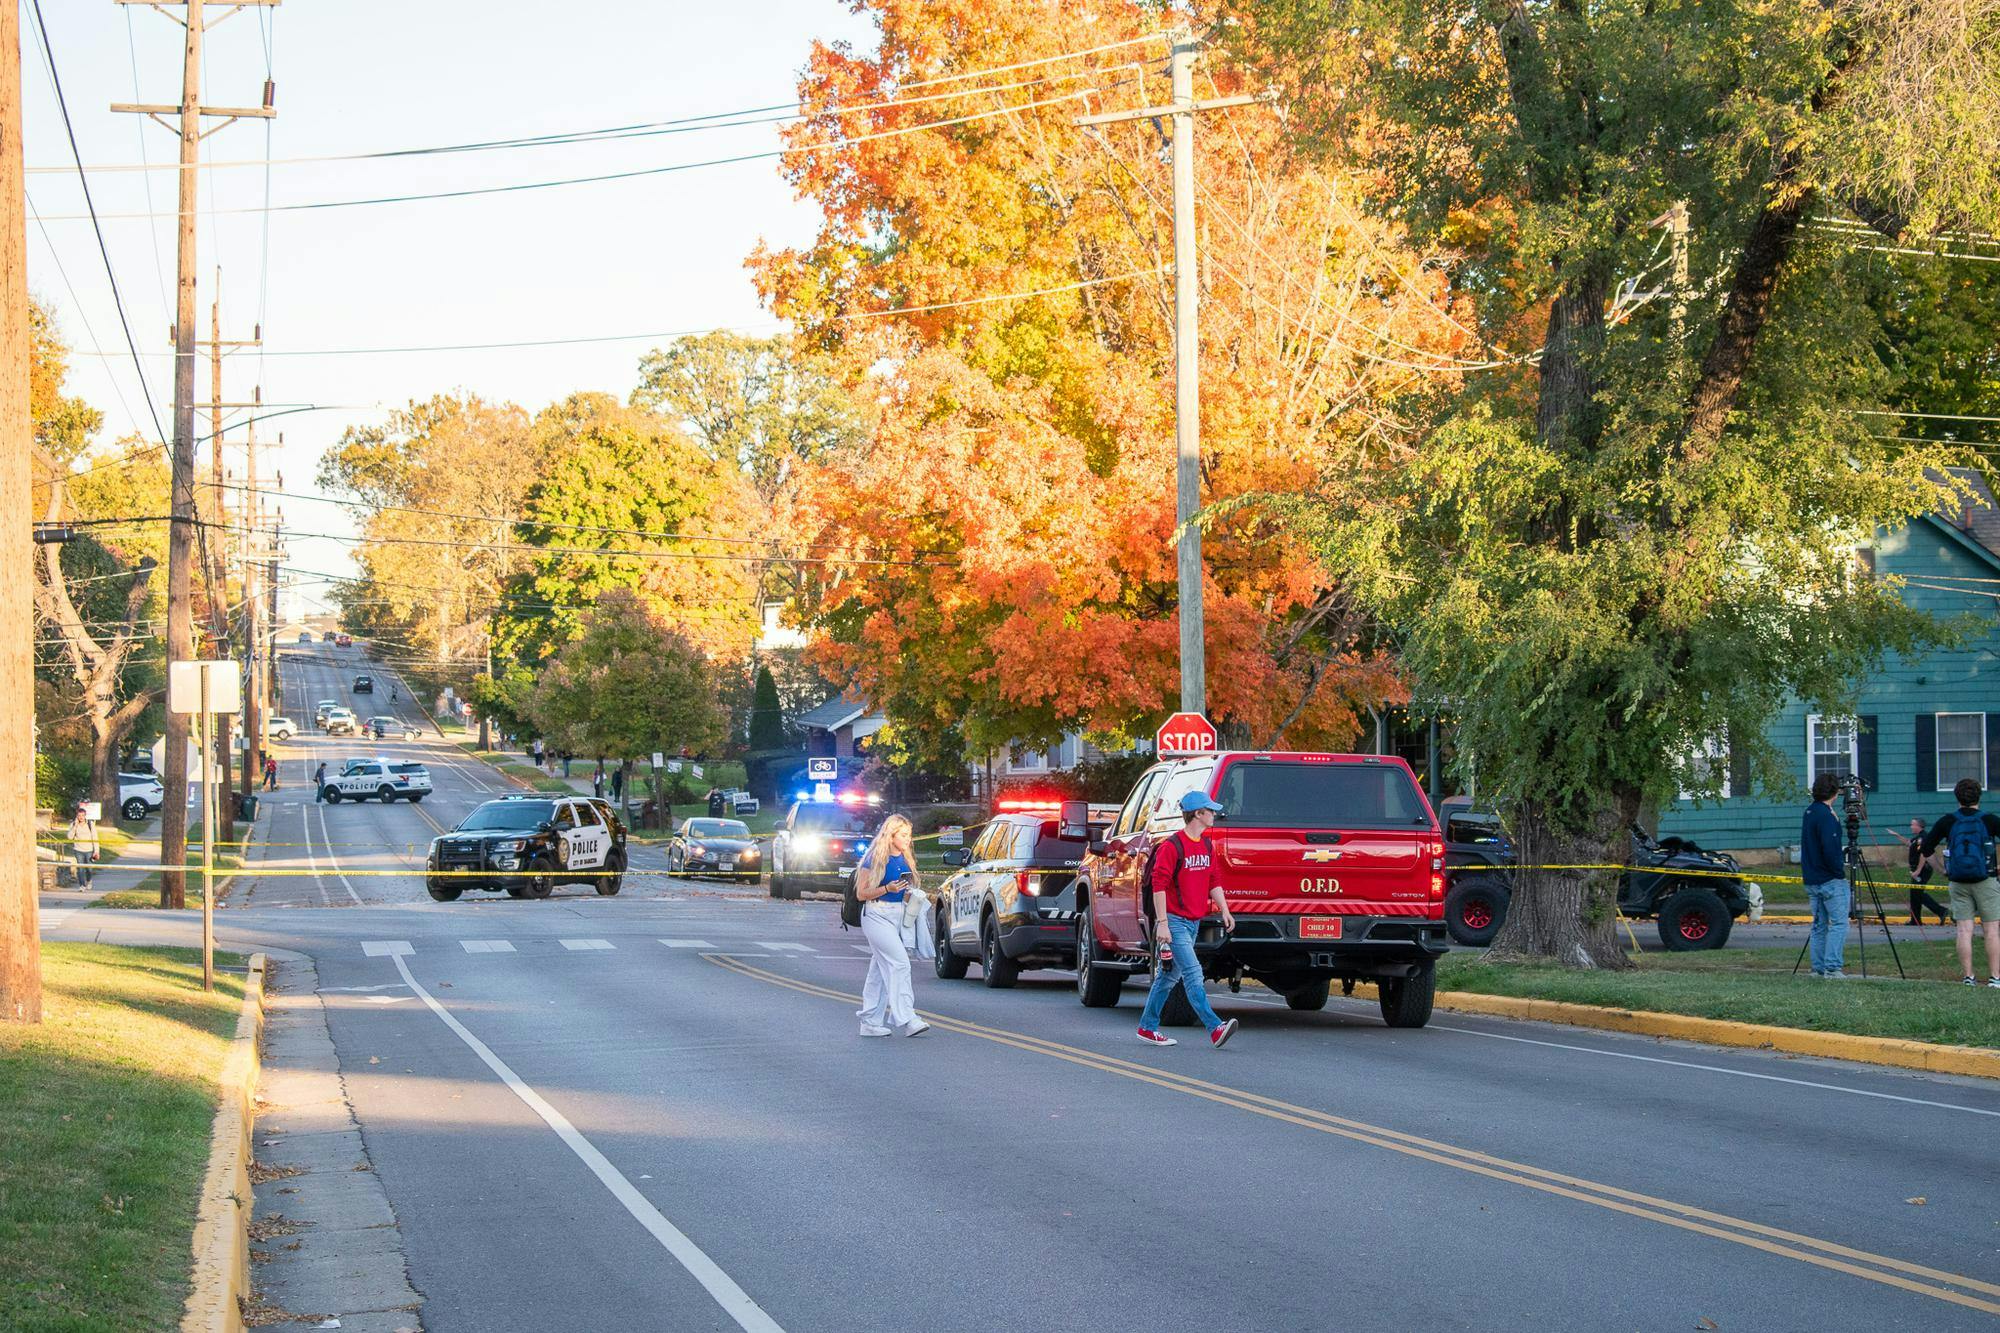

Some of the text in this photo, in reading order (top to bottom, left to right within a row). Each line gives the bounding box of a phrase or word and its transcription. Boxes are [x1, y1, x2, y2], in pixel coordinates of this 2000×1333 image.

[1162, 732, 1213, 752] STOP
[344, 783, 374, 791] POLICE
[572, 840, 597, 855] POLICE
[1184, 854, 1210, 869] MIAMI
[1300, 878, 1343, 893] O.F.D.
[960, 895, 980, 917] POLICE
